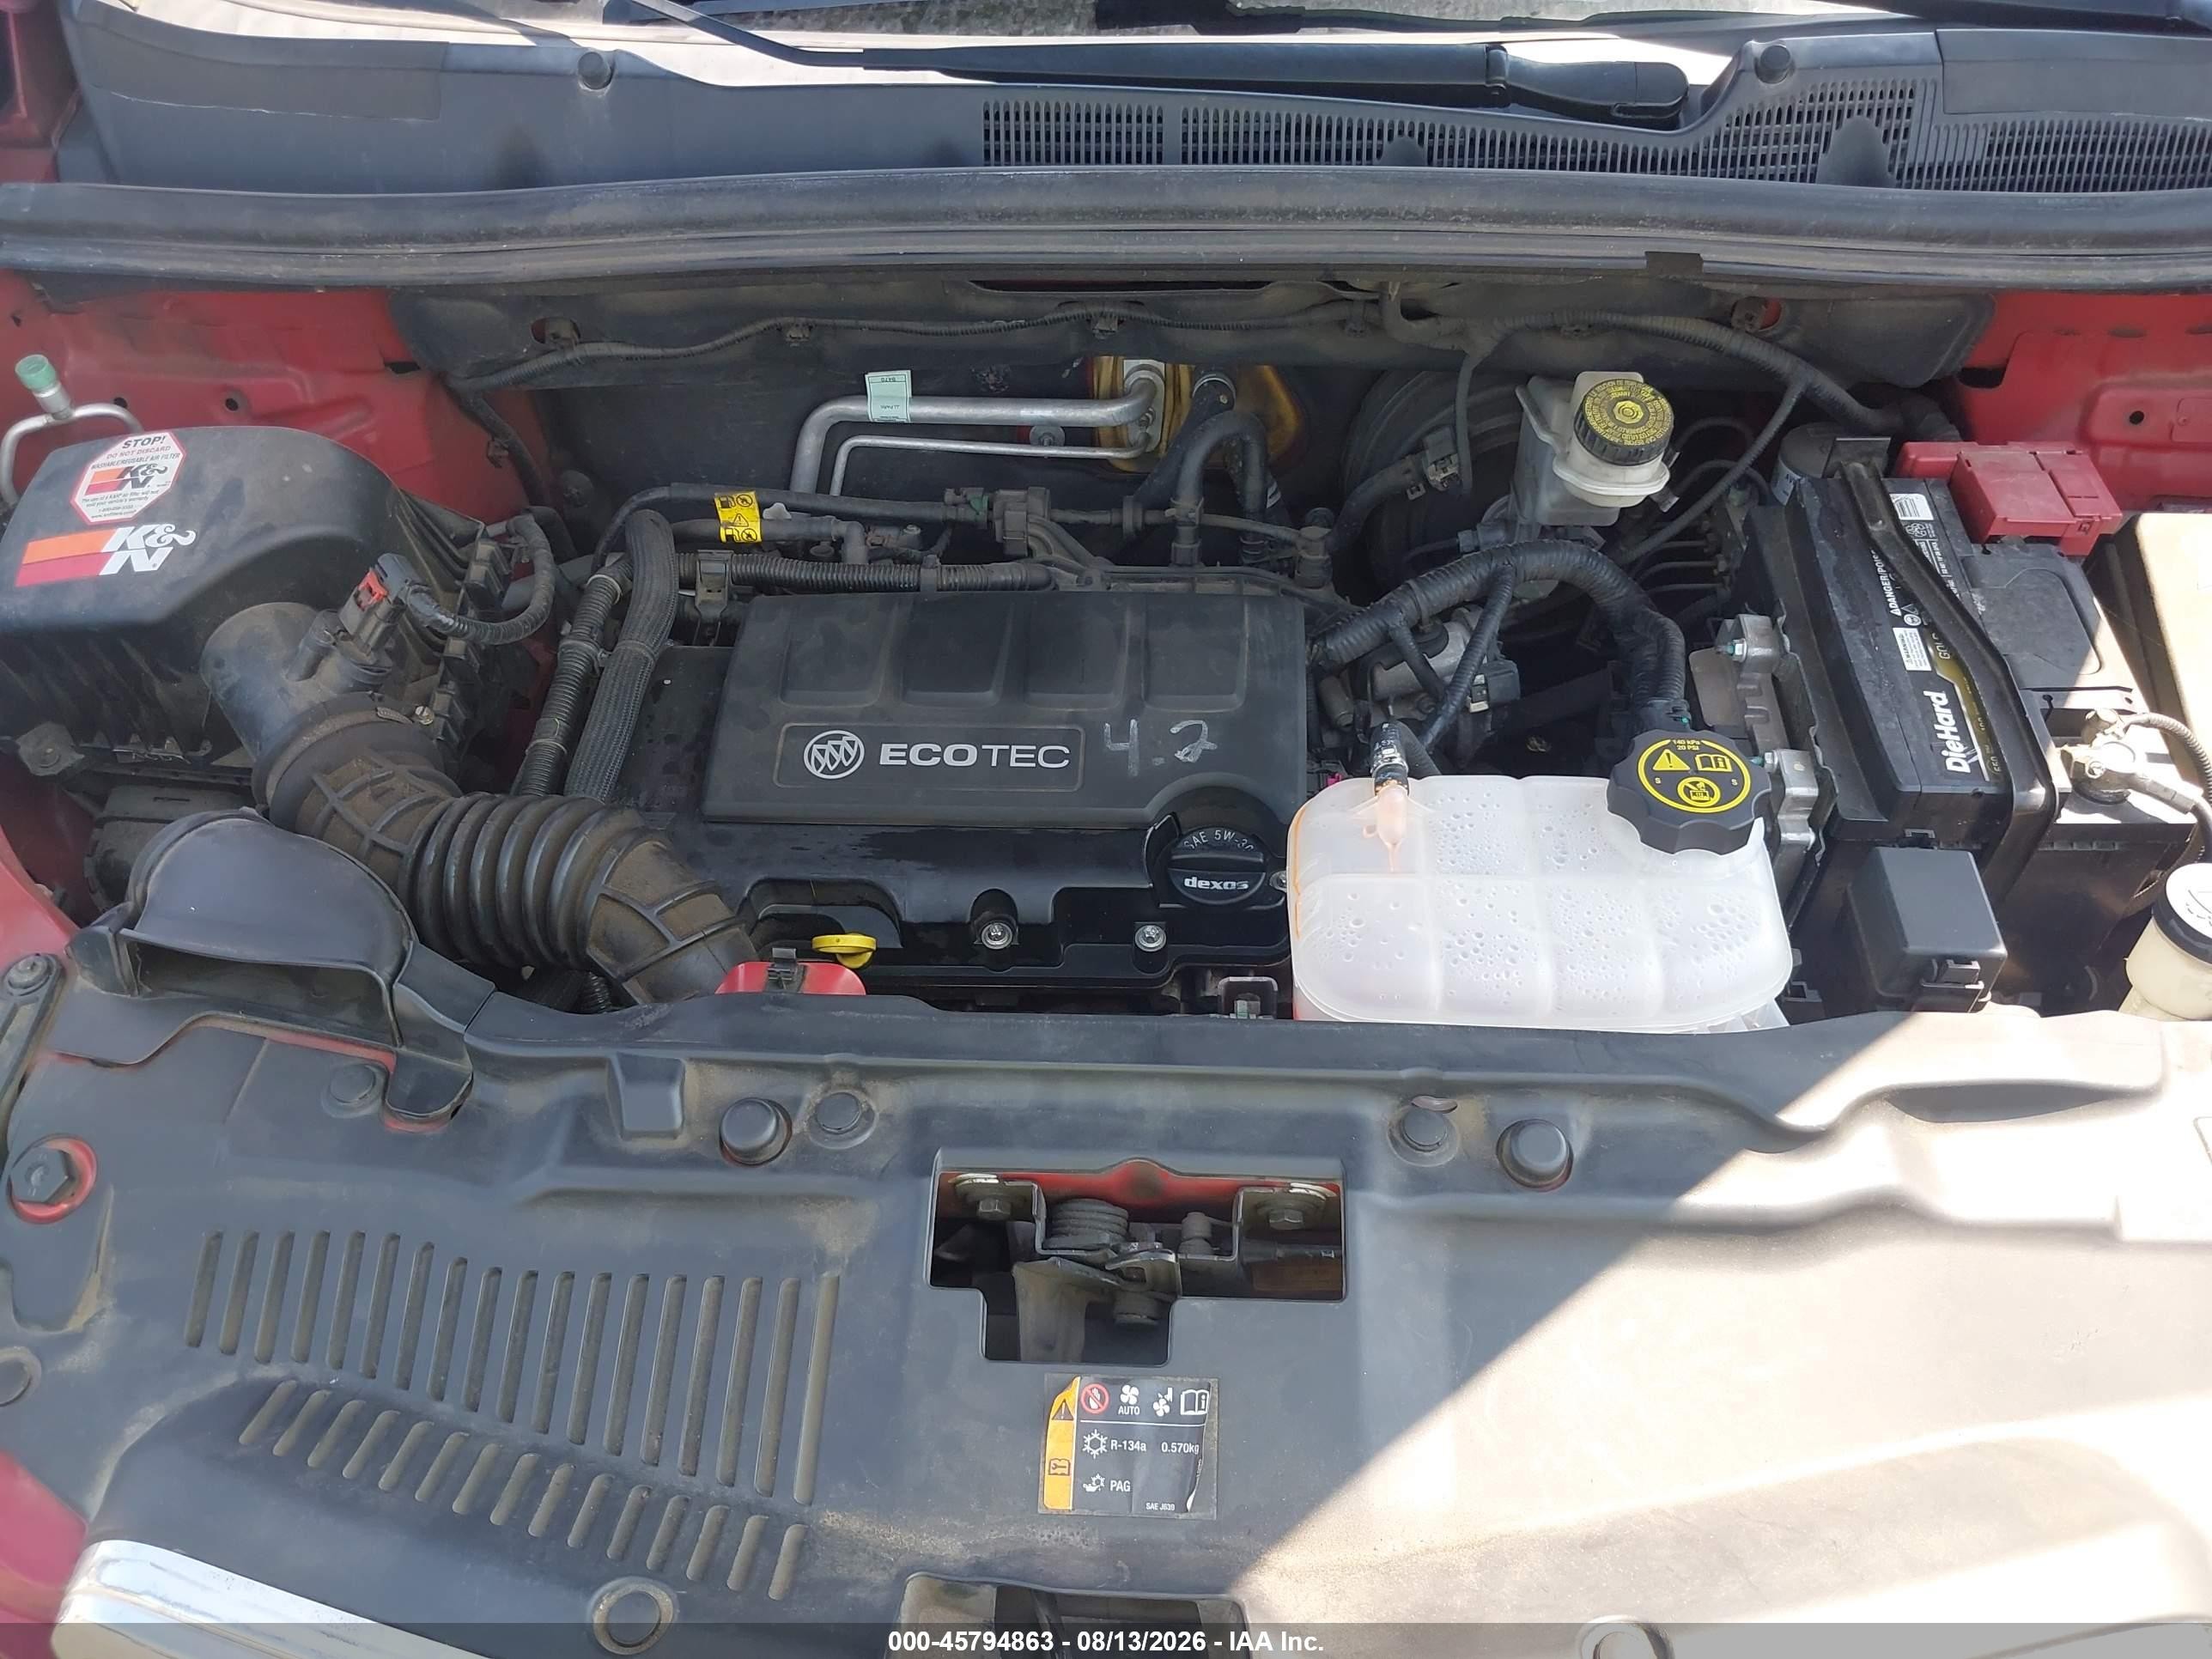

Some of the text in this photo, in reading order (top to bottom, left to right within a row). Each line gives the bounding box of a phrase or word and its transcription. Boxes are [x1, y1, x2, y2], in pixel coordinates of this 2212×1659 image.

[122, 436, 167, 449] STOP!
[137, 446, 172, 455] DISCARD
[1923, 690, 1971, 773] DieHard
[1103, 719, 1218, 776] 4.2
[879, 743, 1070, 769] ECOTEC
[1184, 831, 1208, 849] SAE
[1184, 877, 1249, 890] dexos
[1118, 1407, 1140, 1416] AUTO
[1110, 1440, 1200, 1455] R-134a 0.570kg
[1110, 1480, 1131, 1492] PAG
